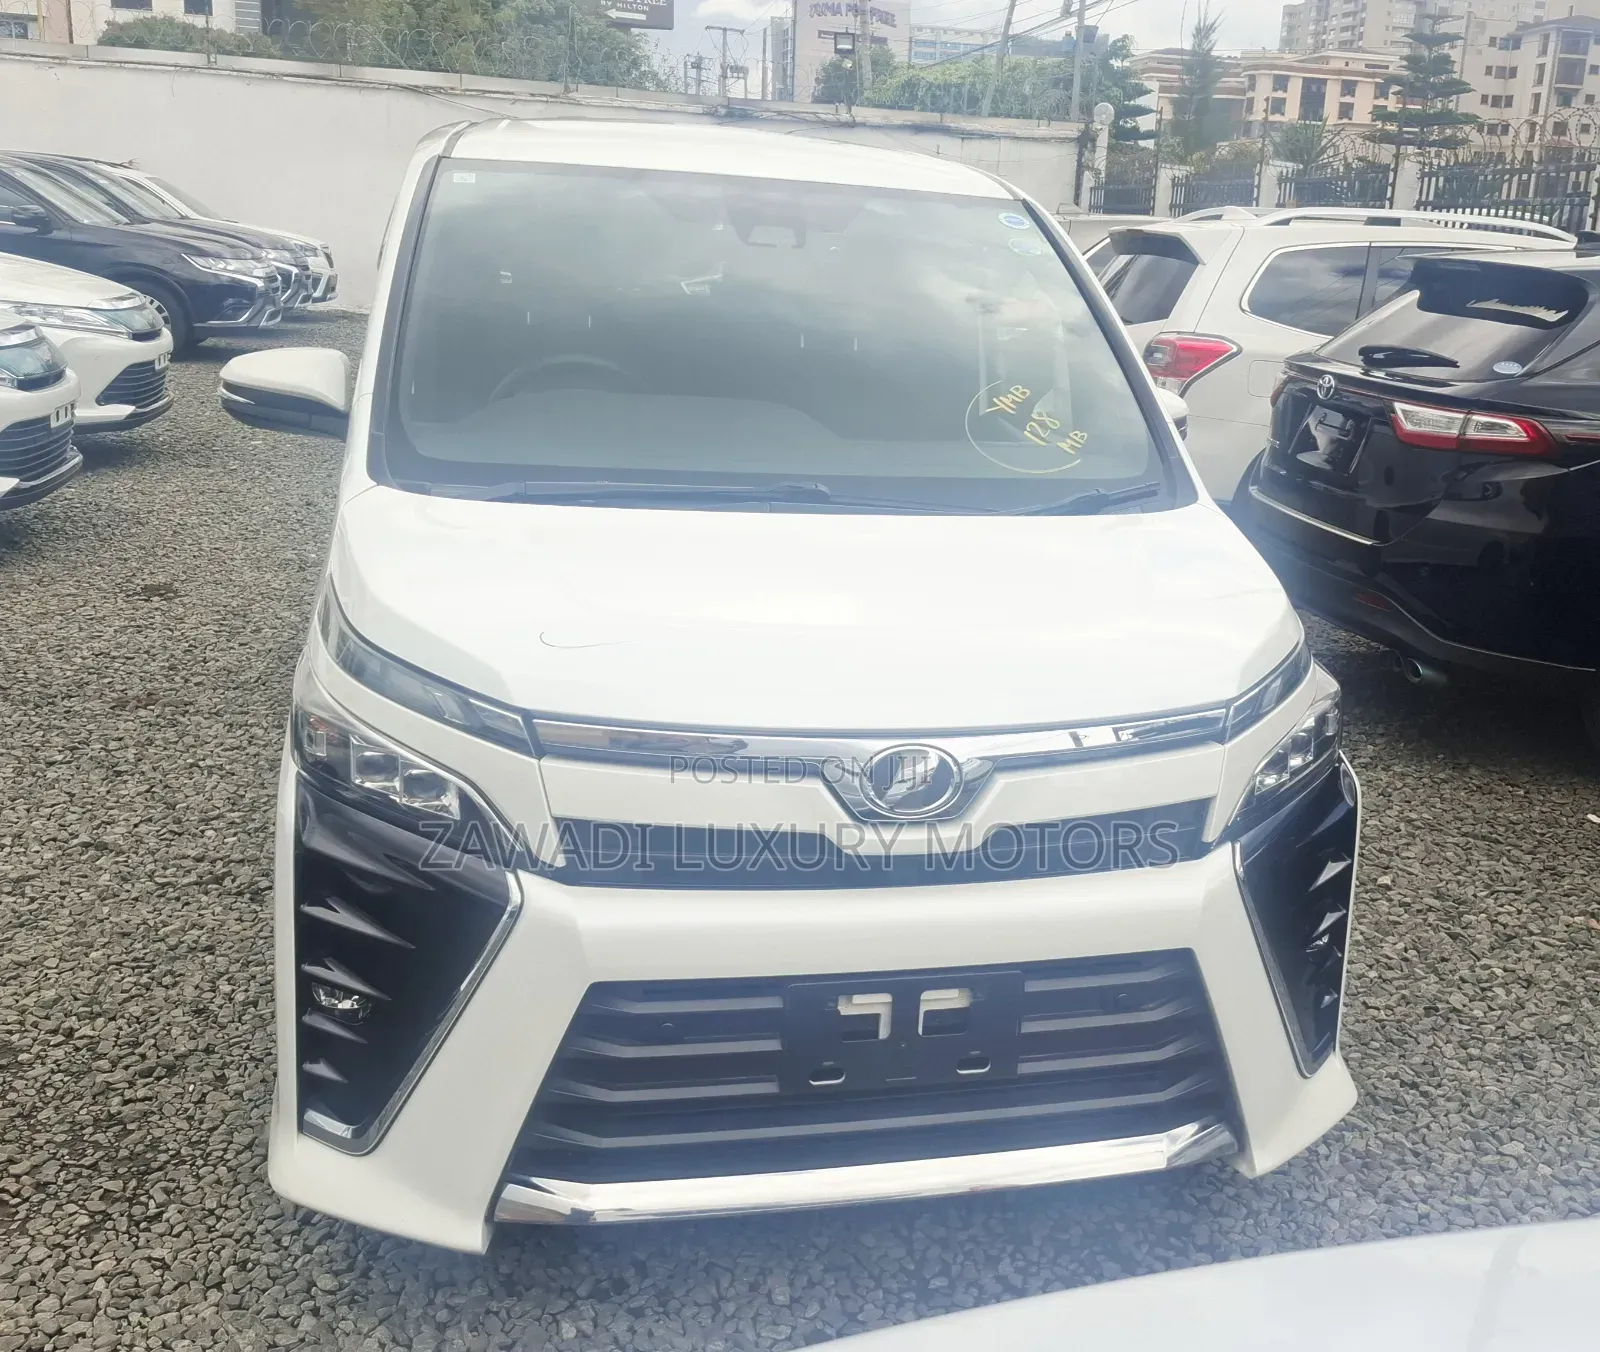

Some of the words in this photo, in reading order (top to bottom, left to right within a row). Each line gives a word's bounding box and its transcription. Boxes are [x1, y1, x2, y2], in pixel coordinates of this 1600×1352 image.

[617, 2, 649, 11] HILTON
[1023, 411, 1060, 446] 128
[1057, 430, 1088, 455] MB
